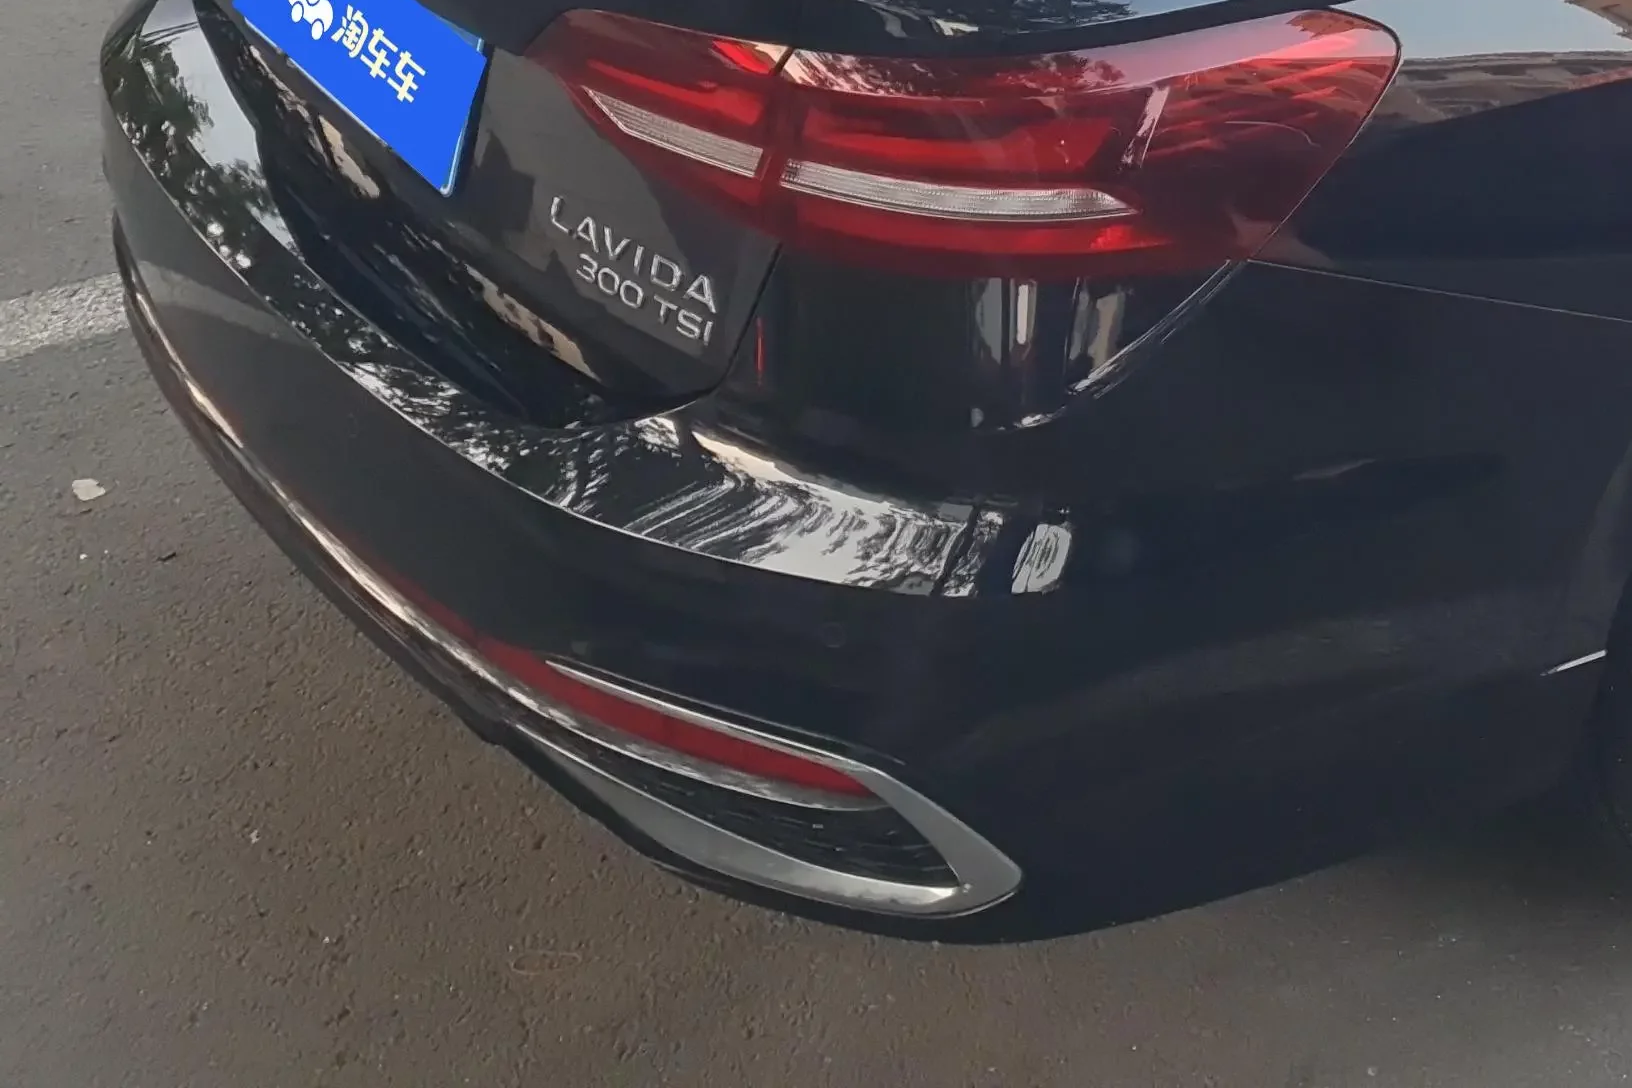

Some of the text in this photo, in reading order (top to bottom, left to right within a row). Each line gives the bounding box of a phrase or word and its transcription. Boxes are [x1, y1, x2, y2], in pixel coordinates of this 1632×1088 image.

[551, 196, 717, 314] LAVIDA
[576, 252, 714, 346] 300 TSI
